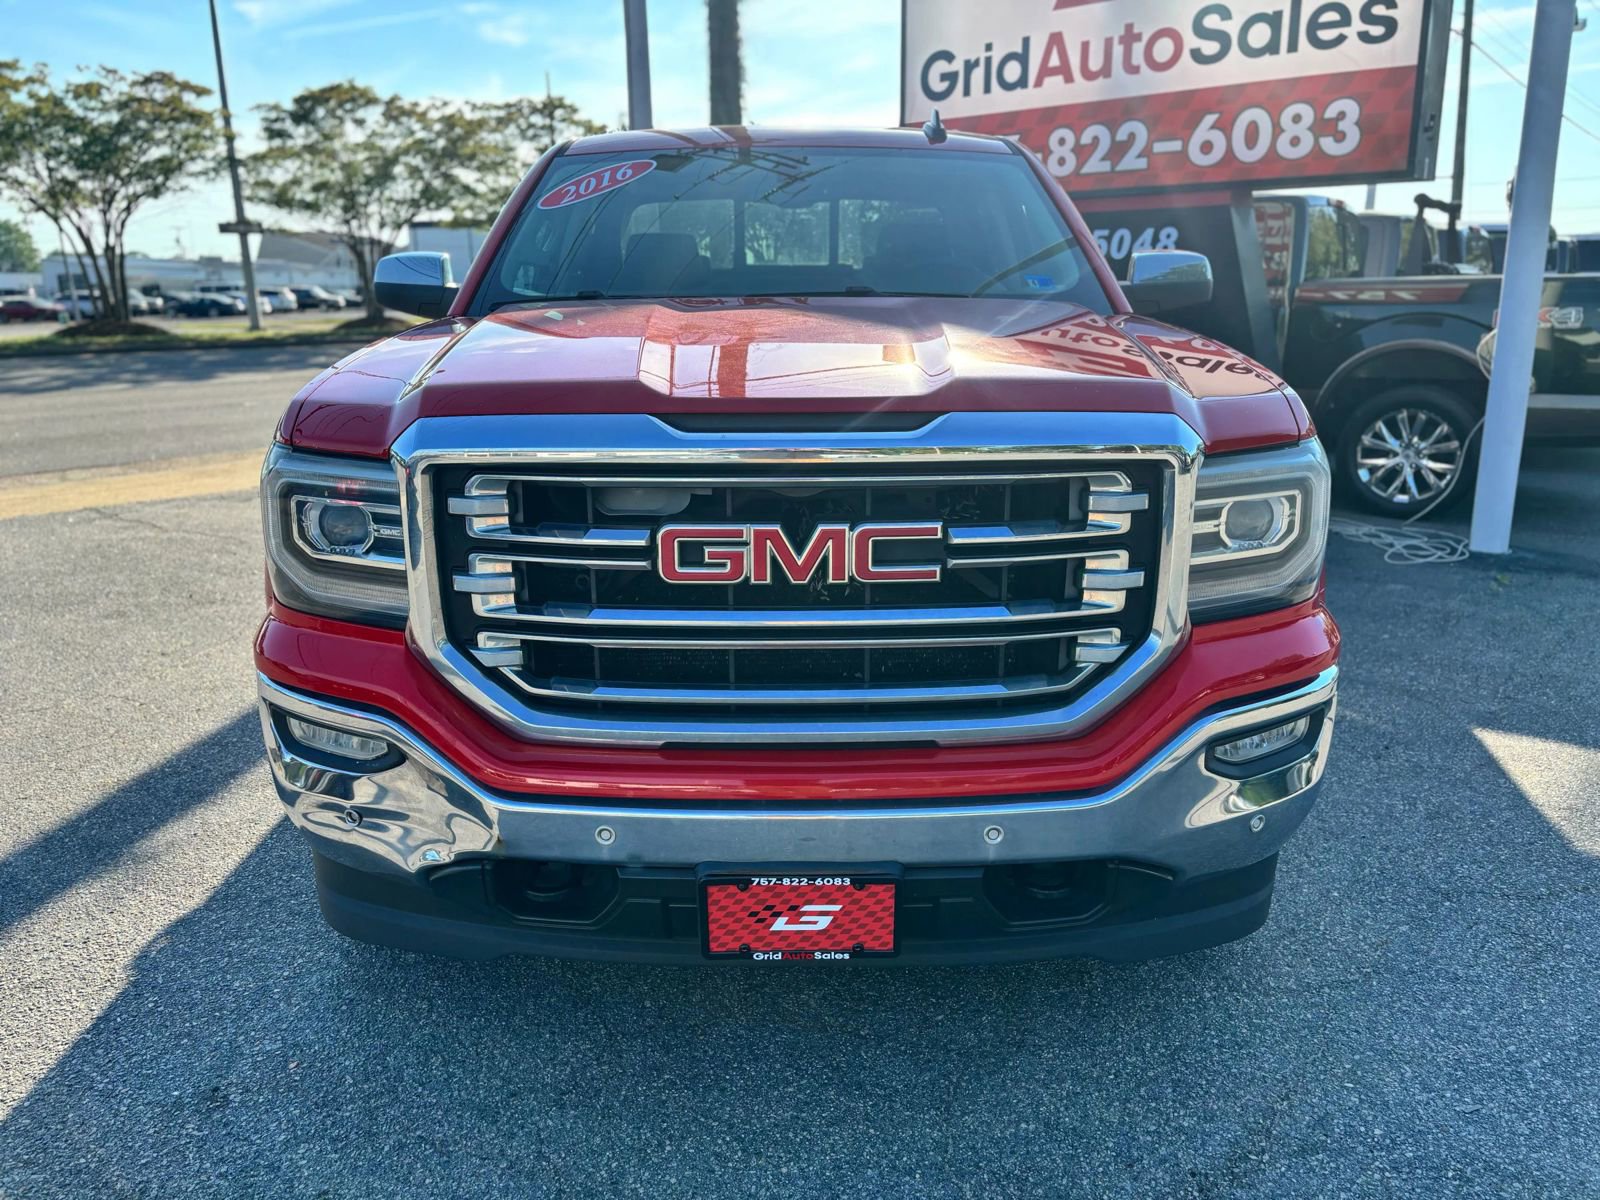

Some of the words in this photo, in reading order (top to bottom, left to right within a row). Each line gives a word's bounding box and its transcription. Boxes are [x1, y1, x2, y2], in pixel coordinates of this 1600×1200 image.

[920, 0, 1400, 102] GridAutoSales
[1034, 97, 1362, 178] 822-6083
[560, 162, 633, 204] 2016
[380, 528, 401, 536] GMC
[657, 521, 943, 585] GMC
[751, 877, 851, 886] 757-822-6083
[753, 951, 850, 960] GridAutoSales
